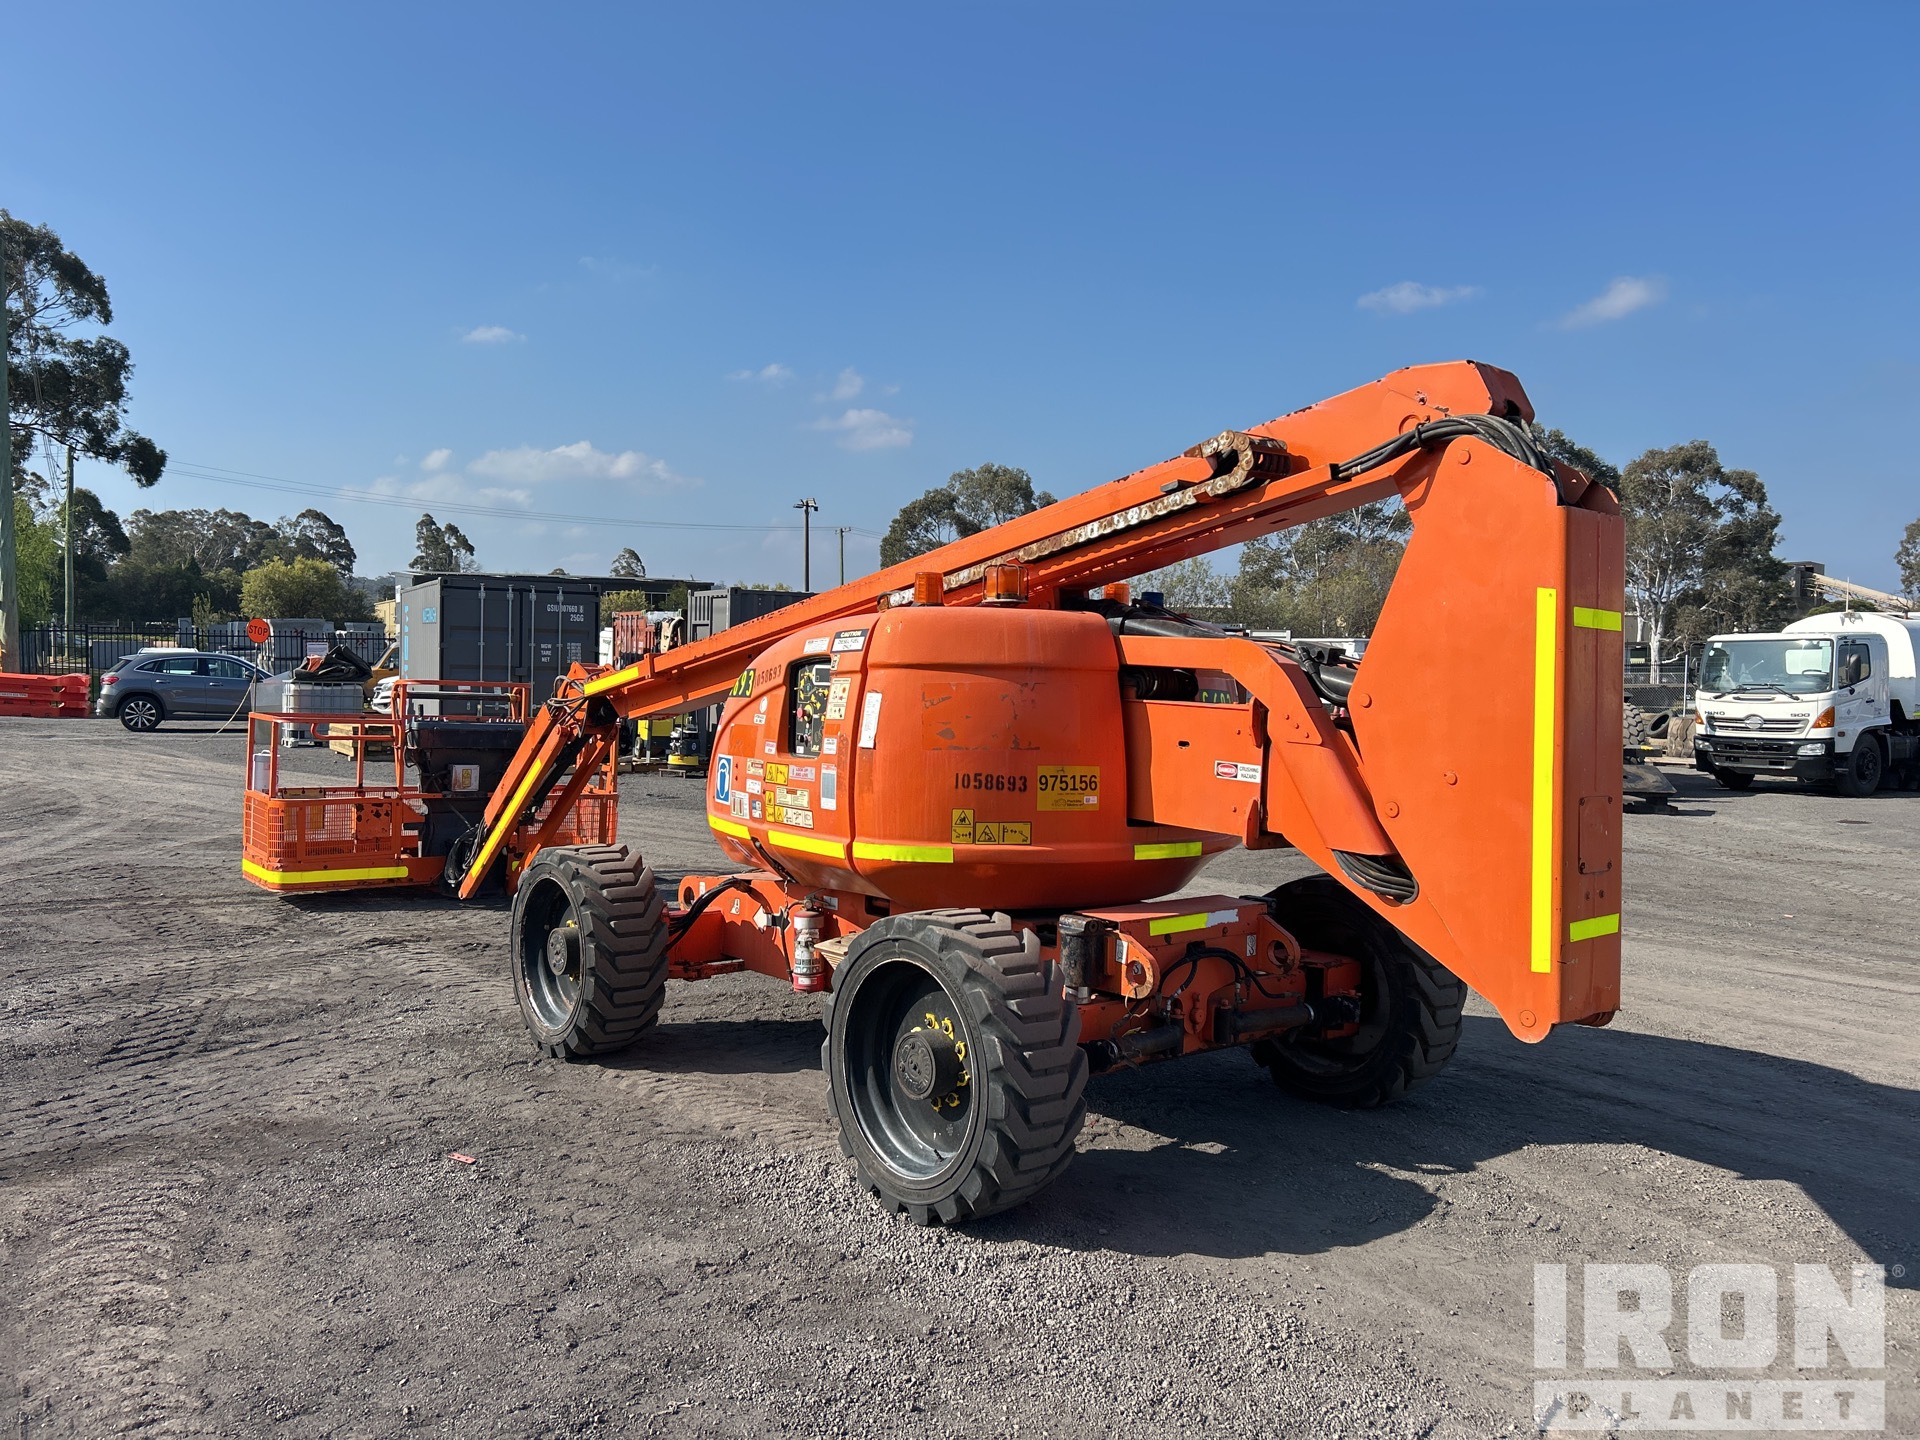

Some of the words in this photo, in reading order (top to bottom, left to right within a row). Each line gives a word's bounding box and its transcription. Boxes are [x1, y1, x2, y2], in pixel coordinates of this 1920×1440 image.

[547, 604, 559, 612] GSIU
[249, 625, 268, 636] STOP
[754, 664, 782, 689] 1058693
[955, 773, 1028, 793] 1058693
[1038, 774, 1098, 792] 975156
